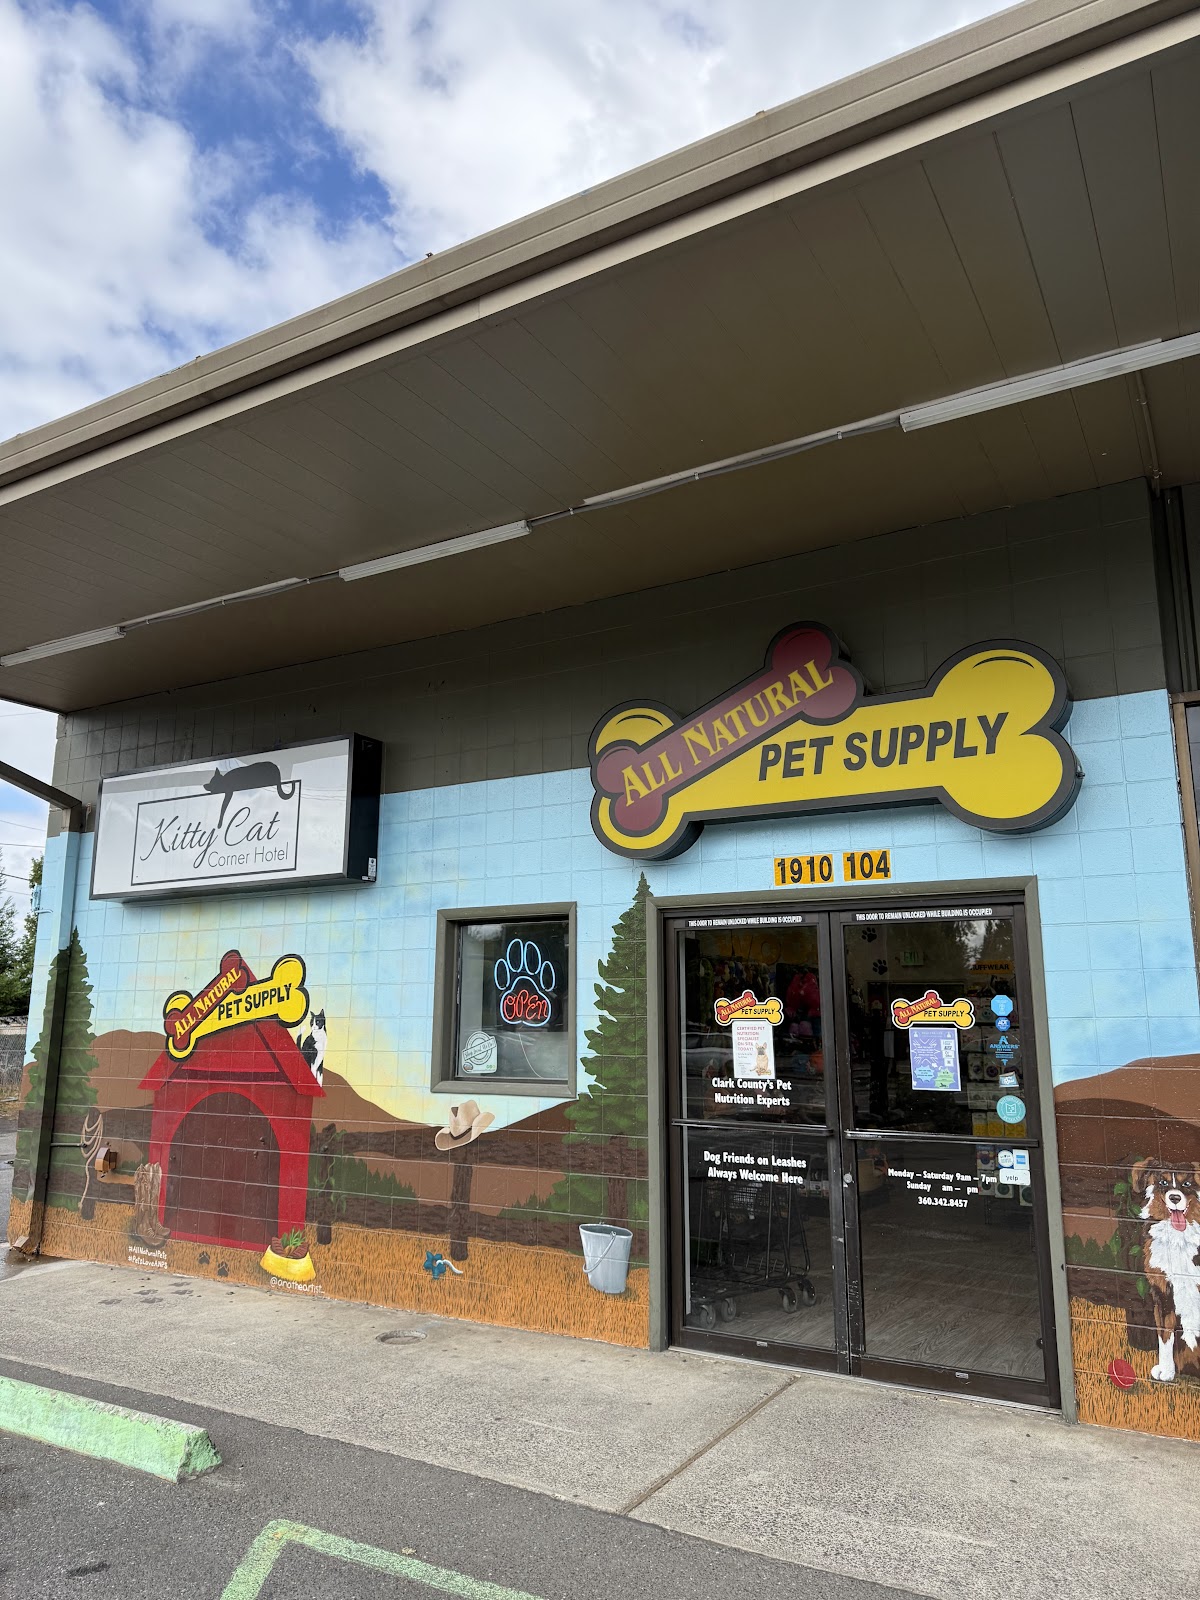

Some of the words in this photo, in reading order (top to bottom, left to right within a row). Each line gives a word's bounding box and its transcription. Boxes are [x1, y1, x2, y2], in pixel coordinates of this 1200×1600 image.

[621, 751, 683, 806] ALL
[681, 659, 834, 766] NATURAL
[759, 736, 834, 782] PET
[843, 712, 1009, 771] SUPPLY
[140, 815, 218, 868] Kitty
[224, 806, 280, 846] Cat
[208, 851, 250, 868] Corner
[254, 842, 289, 863] Hotel
[777, 855, 832, 884] 1910
[847, 850, 890, 880] 104
[856, 913, 865, 921] THIS
[866, 913, 878, 921] DOOR
[878, 912, 885, 920] TO
[885, 911, 902, 920] REMAIN
[902, 911, 926, 919] UNLOCKED
[926, 910, 941, 918] WHILE
[941, 909, 963, 917] BUILDING
[969, 908, 993, 916] OCCUPIED
[174, 1016, 197, 1040] ALL
[193, 967, 242, 1018] NATURAL
[218, 998, 242, 1021] PET
[244, 983, 293, 1013] SUPPLY
[504, 989, 548, 1020] OPEN
[721, 1007, 732, 1017] ALL
[731, 996, 753, 1011] NATURAL
[899, 1008, 911, 1019] ALL
[910, 997, 938, 1013] NATURAL
[753, 1007, 776, 1015] SUPPLY
[711, 1078, 735, 1088] Clark
[737, 1079, 774, 1091] County's
[777, 1080, 792, 1091] Pet
[714, 1093, 754, 1105] Nutrition
[757, 1095, 790, 1108] Experts
[703, 1151, 721, 1165] Dog
[722, 1152, 755, 1165] Friends
[757, 1157, 769, 1166] on
[771, 1155, 807, 1168] Leashes
[707, 1167, 737, 1182] Always
[739, 1169, 779, 1182] Welcome
[781, 1172, 803, 1184] Here
[887, 1168, 914, 1180] Monday
[923, 1170, 954, 1182] Saturday
[955, 1173, 971, 1182] 9am
[981, 1174, 997, 1185] 7pm
[906, 1181, 931, 1192] Sunday
[967, 1186, 979, 1195] pm
[917, 1196, 968, 1208] 360.342.8457
[128, 1245, 167, 1260] #AllNaturalPets
[128, 1256, 168, 1270] #PetsLoveANPS
